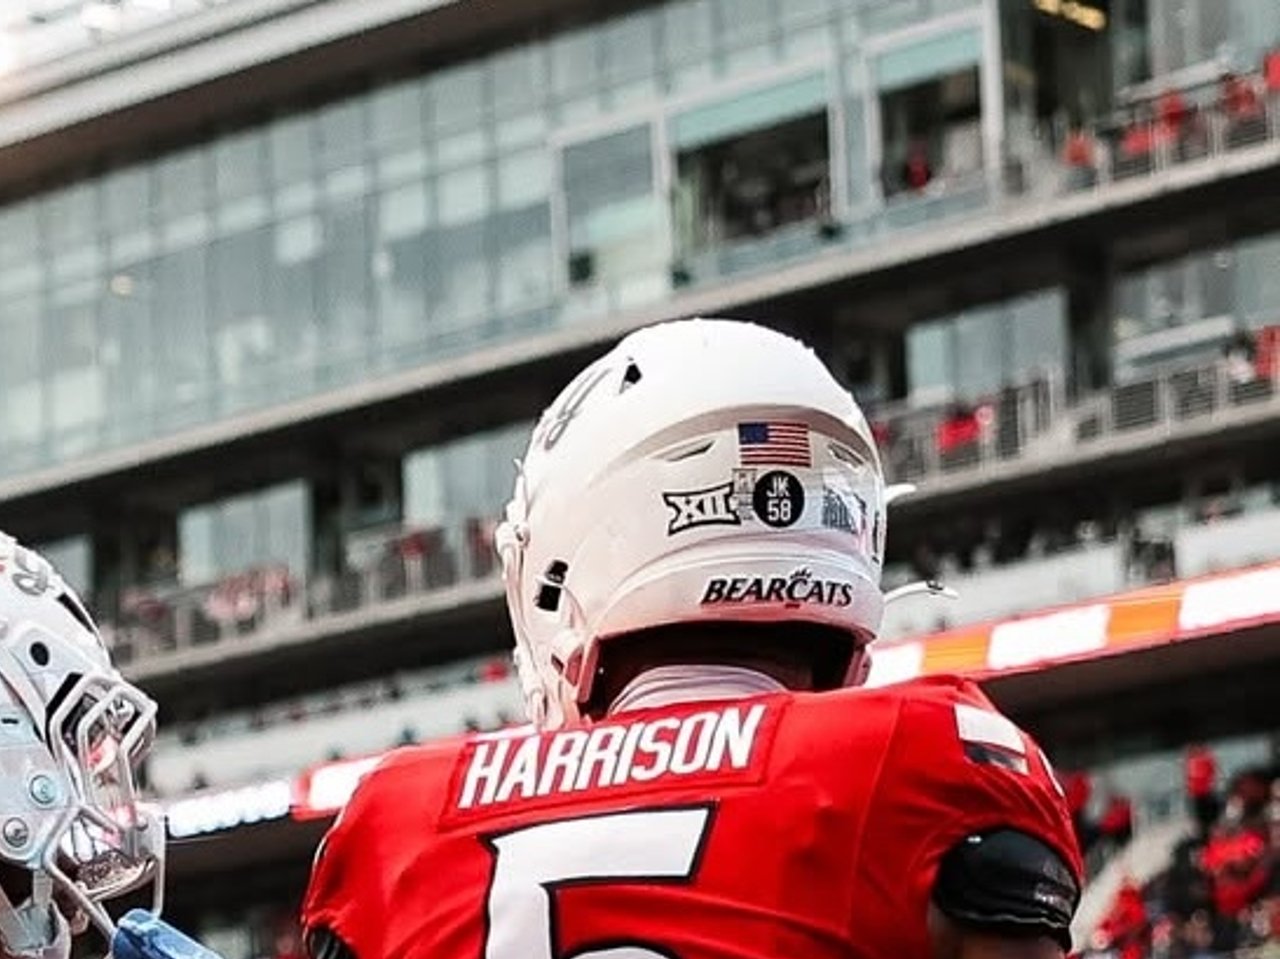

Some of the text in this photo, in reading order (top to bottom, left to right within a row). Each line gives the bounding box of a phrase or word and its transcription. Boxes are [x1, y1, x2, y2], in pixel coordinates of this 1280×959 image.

[766, 476, 791, 498] JK
[767, 500, 792, 522] 58
[701, 574, 853, 607] BEARCATS
[458, 704, 767, 809] HARRISON
